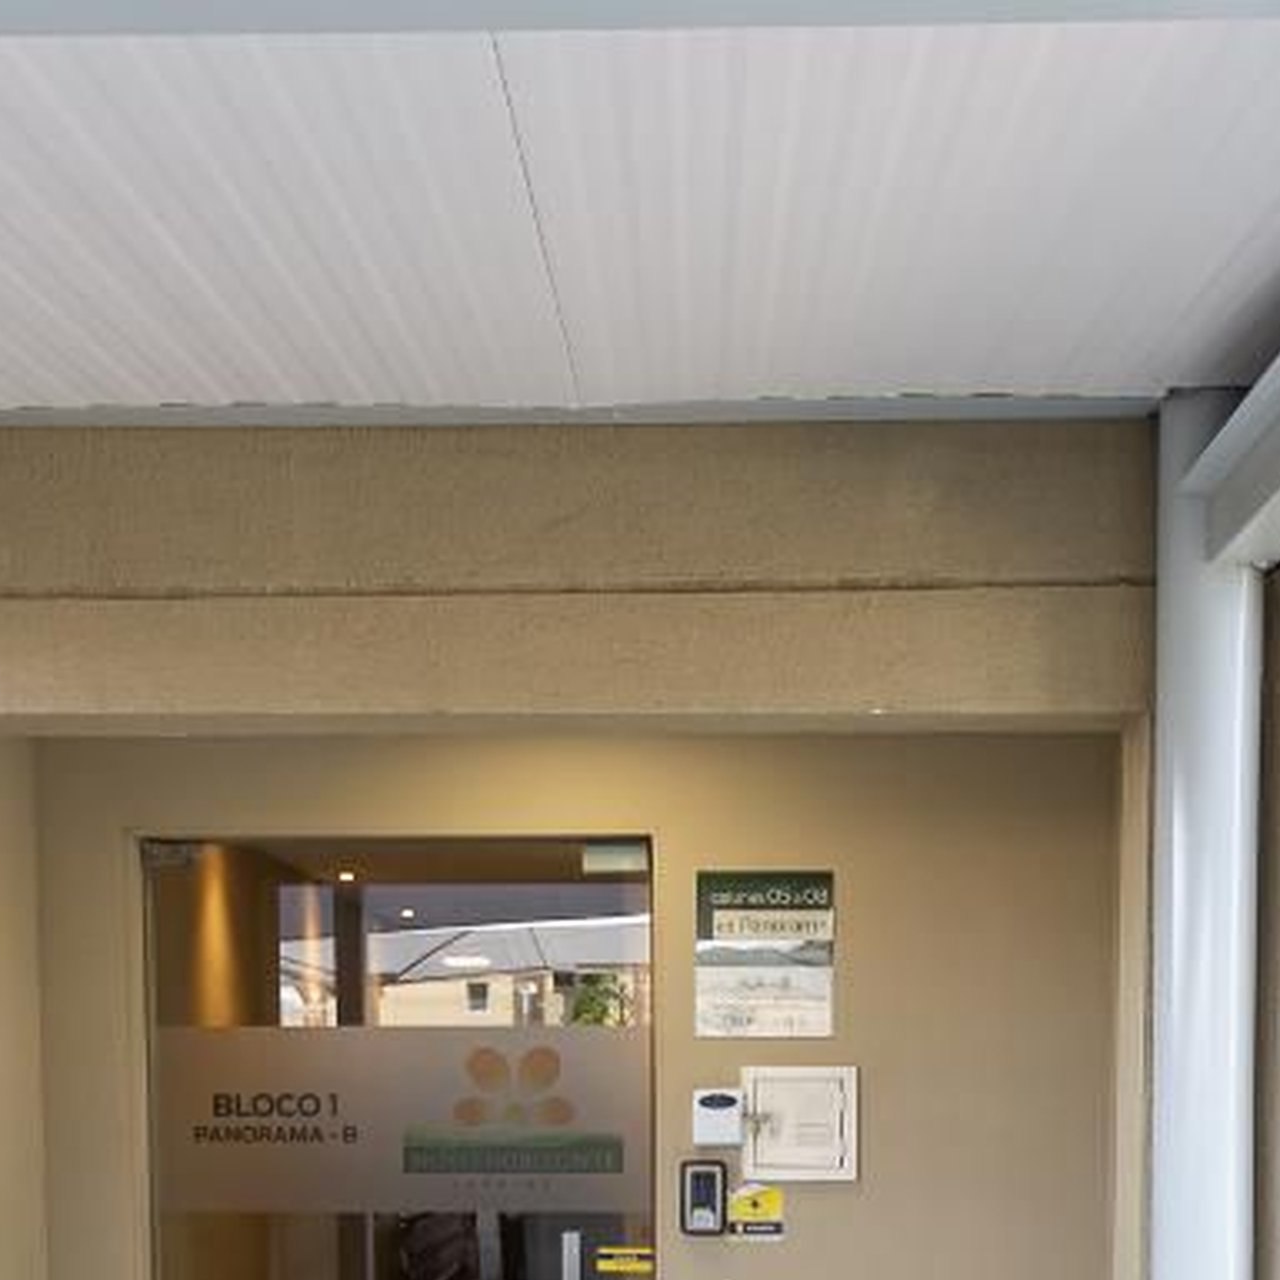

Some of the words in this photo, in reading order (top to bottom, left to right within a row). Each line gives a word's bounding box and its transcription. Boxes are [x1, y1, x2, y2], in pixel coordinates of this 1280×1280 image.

[212, 1091, 322, 1119] BLOCO
[328, 1092, 338, 1118] 1
[193, 1124, 324, 1145] PANORAMA
[341, 1125, 358, 1144] B
